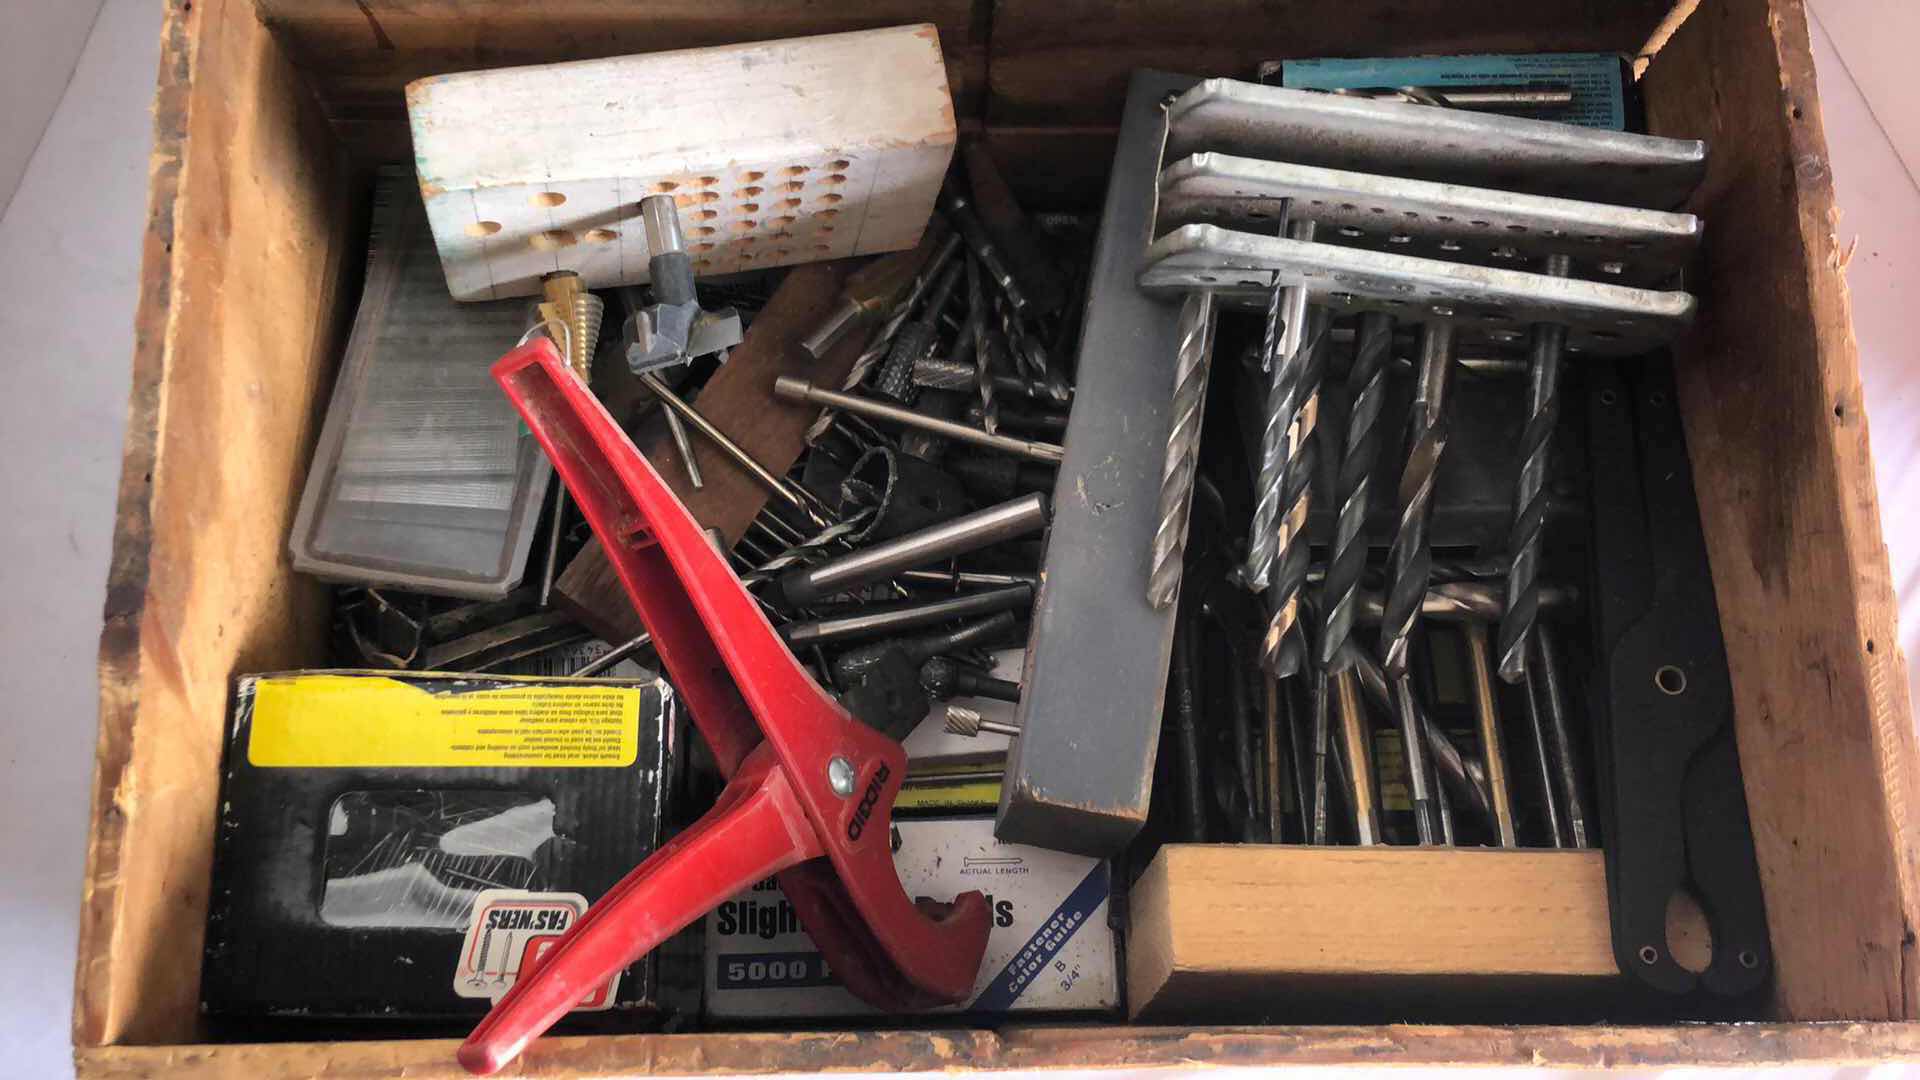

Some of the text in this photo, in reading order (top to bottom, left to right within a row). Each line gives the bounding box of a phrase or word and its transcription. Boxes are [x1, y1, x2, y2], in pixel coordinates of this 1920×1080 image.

[959, 866, 1029, 875] ACTUAL LENGTH
[486, 909, 569, 931] FAS'NERS
[1007, 911, 1066, 976] Fastener
[1008, 911, 1082, 993] Color Guide
[728, 960, 807, 981] 5000
[1055, 960, 1066, 972] B
[1061, 963, 1081, 992] 3/4"
